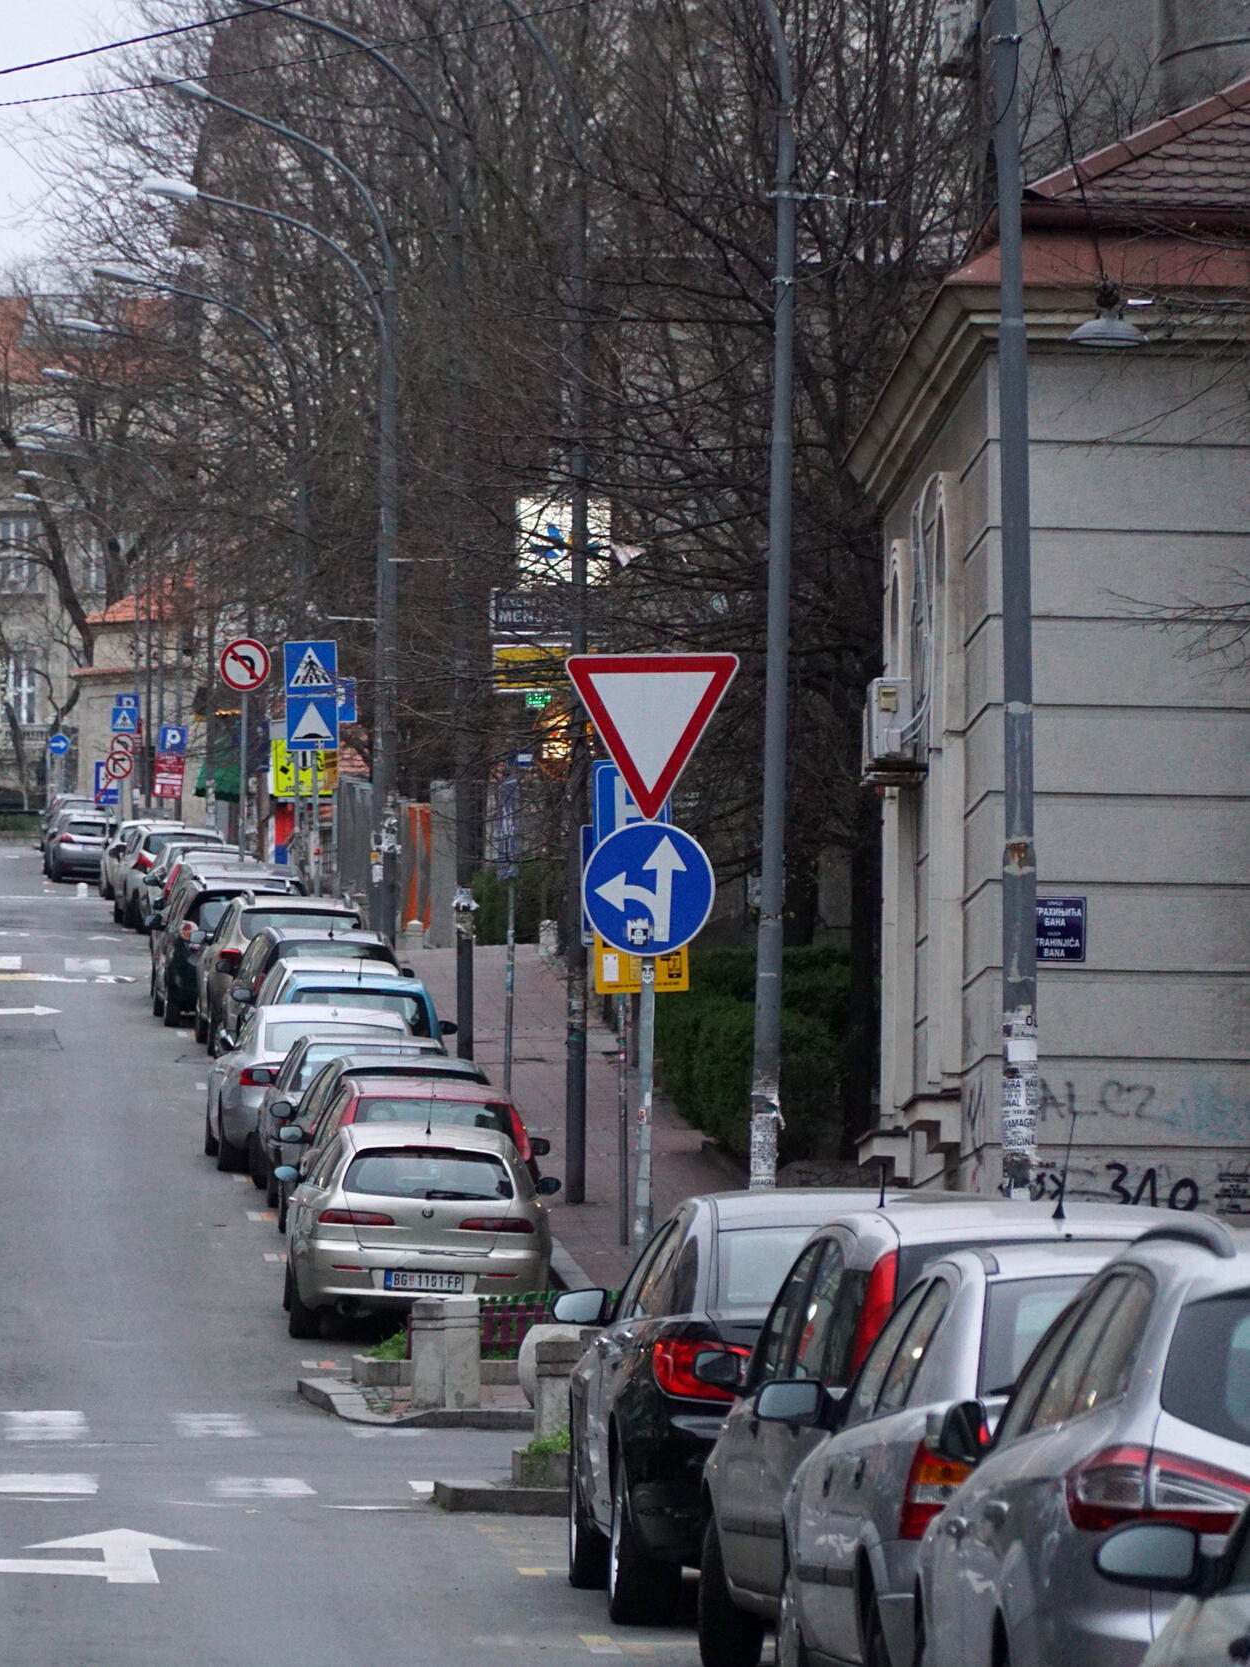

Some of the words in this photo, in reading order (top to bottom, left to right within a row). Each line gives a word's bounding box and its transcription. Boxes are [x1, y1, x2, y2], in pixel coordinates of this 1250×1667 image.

[165, 729, 181, 749] P
[1035, 908, 1082, 917] ТРАХИЊИЋА
[1044, 918, 1066, 927] БАНА
[1035, 936, 1081, 948] TRAHINJIĆA
[1043, 948, 1066, 957] BANA
[393, 1273, 407, 1286] BG
